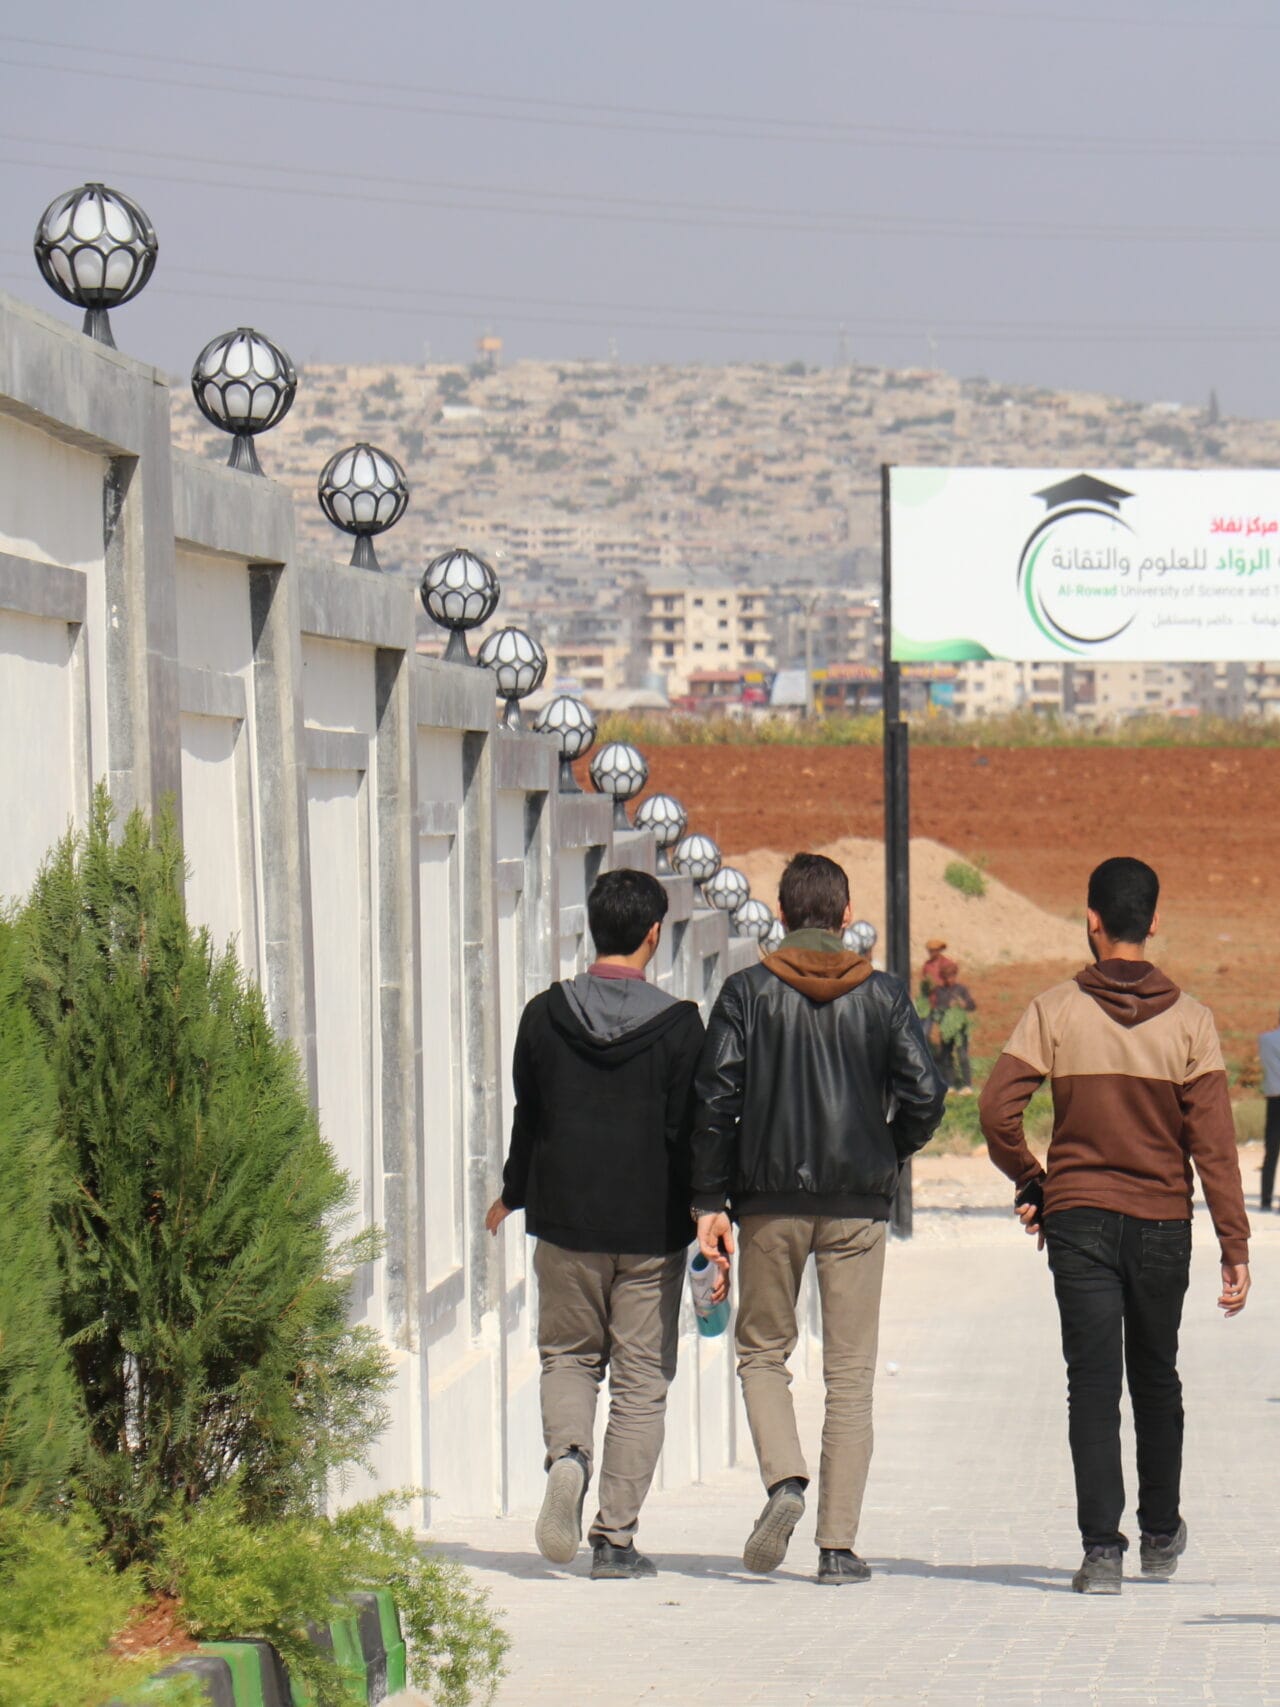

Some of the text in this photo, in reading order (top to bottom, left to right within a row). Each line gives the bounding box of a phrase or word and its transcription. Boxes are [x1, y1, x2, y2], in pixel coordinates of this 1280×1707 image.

[1245, 516, 1279, 536] مركز
[1051, 547, 1131, 576] والتقانة
[1138, 547, 1207, 582] للعلوم
[1121, 584, 1179, 600] University
[1182, 584, 1195, 598] of
[1198, 584, 1244, 598] Science
[1248, 584, 1270, 598] and
